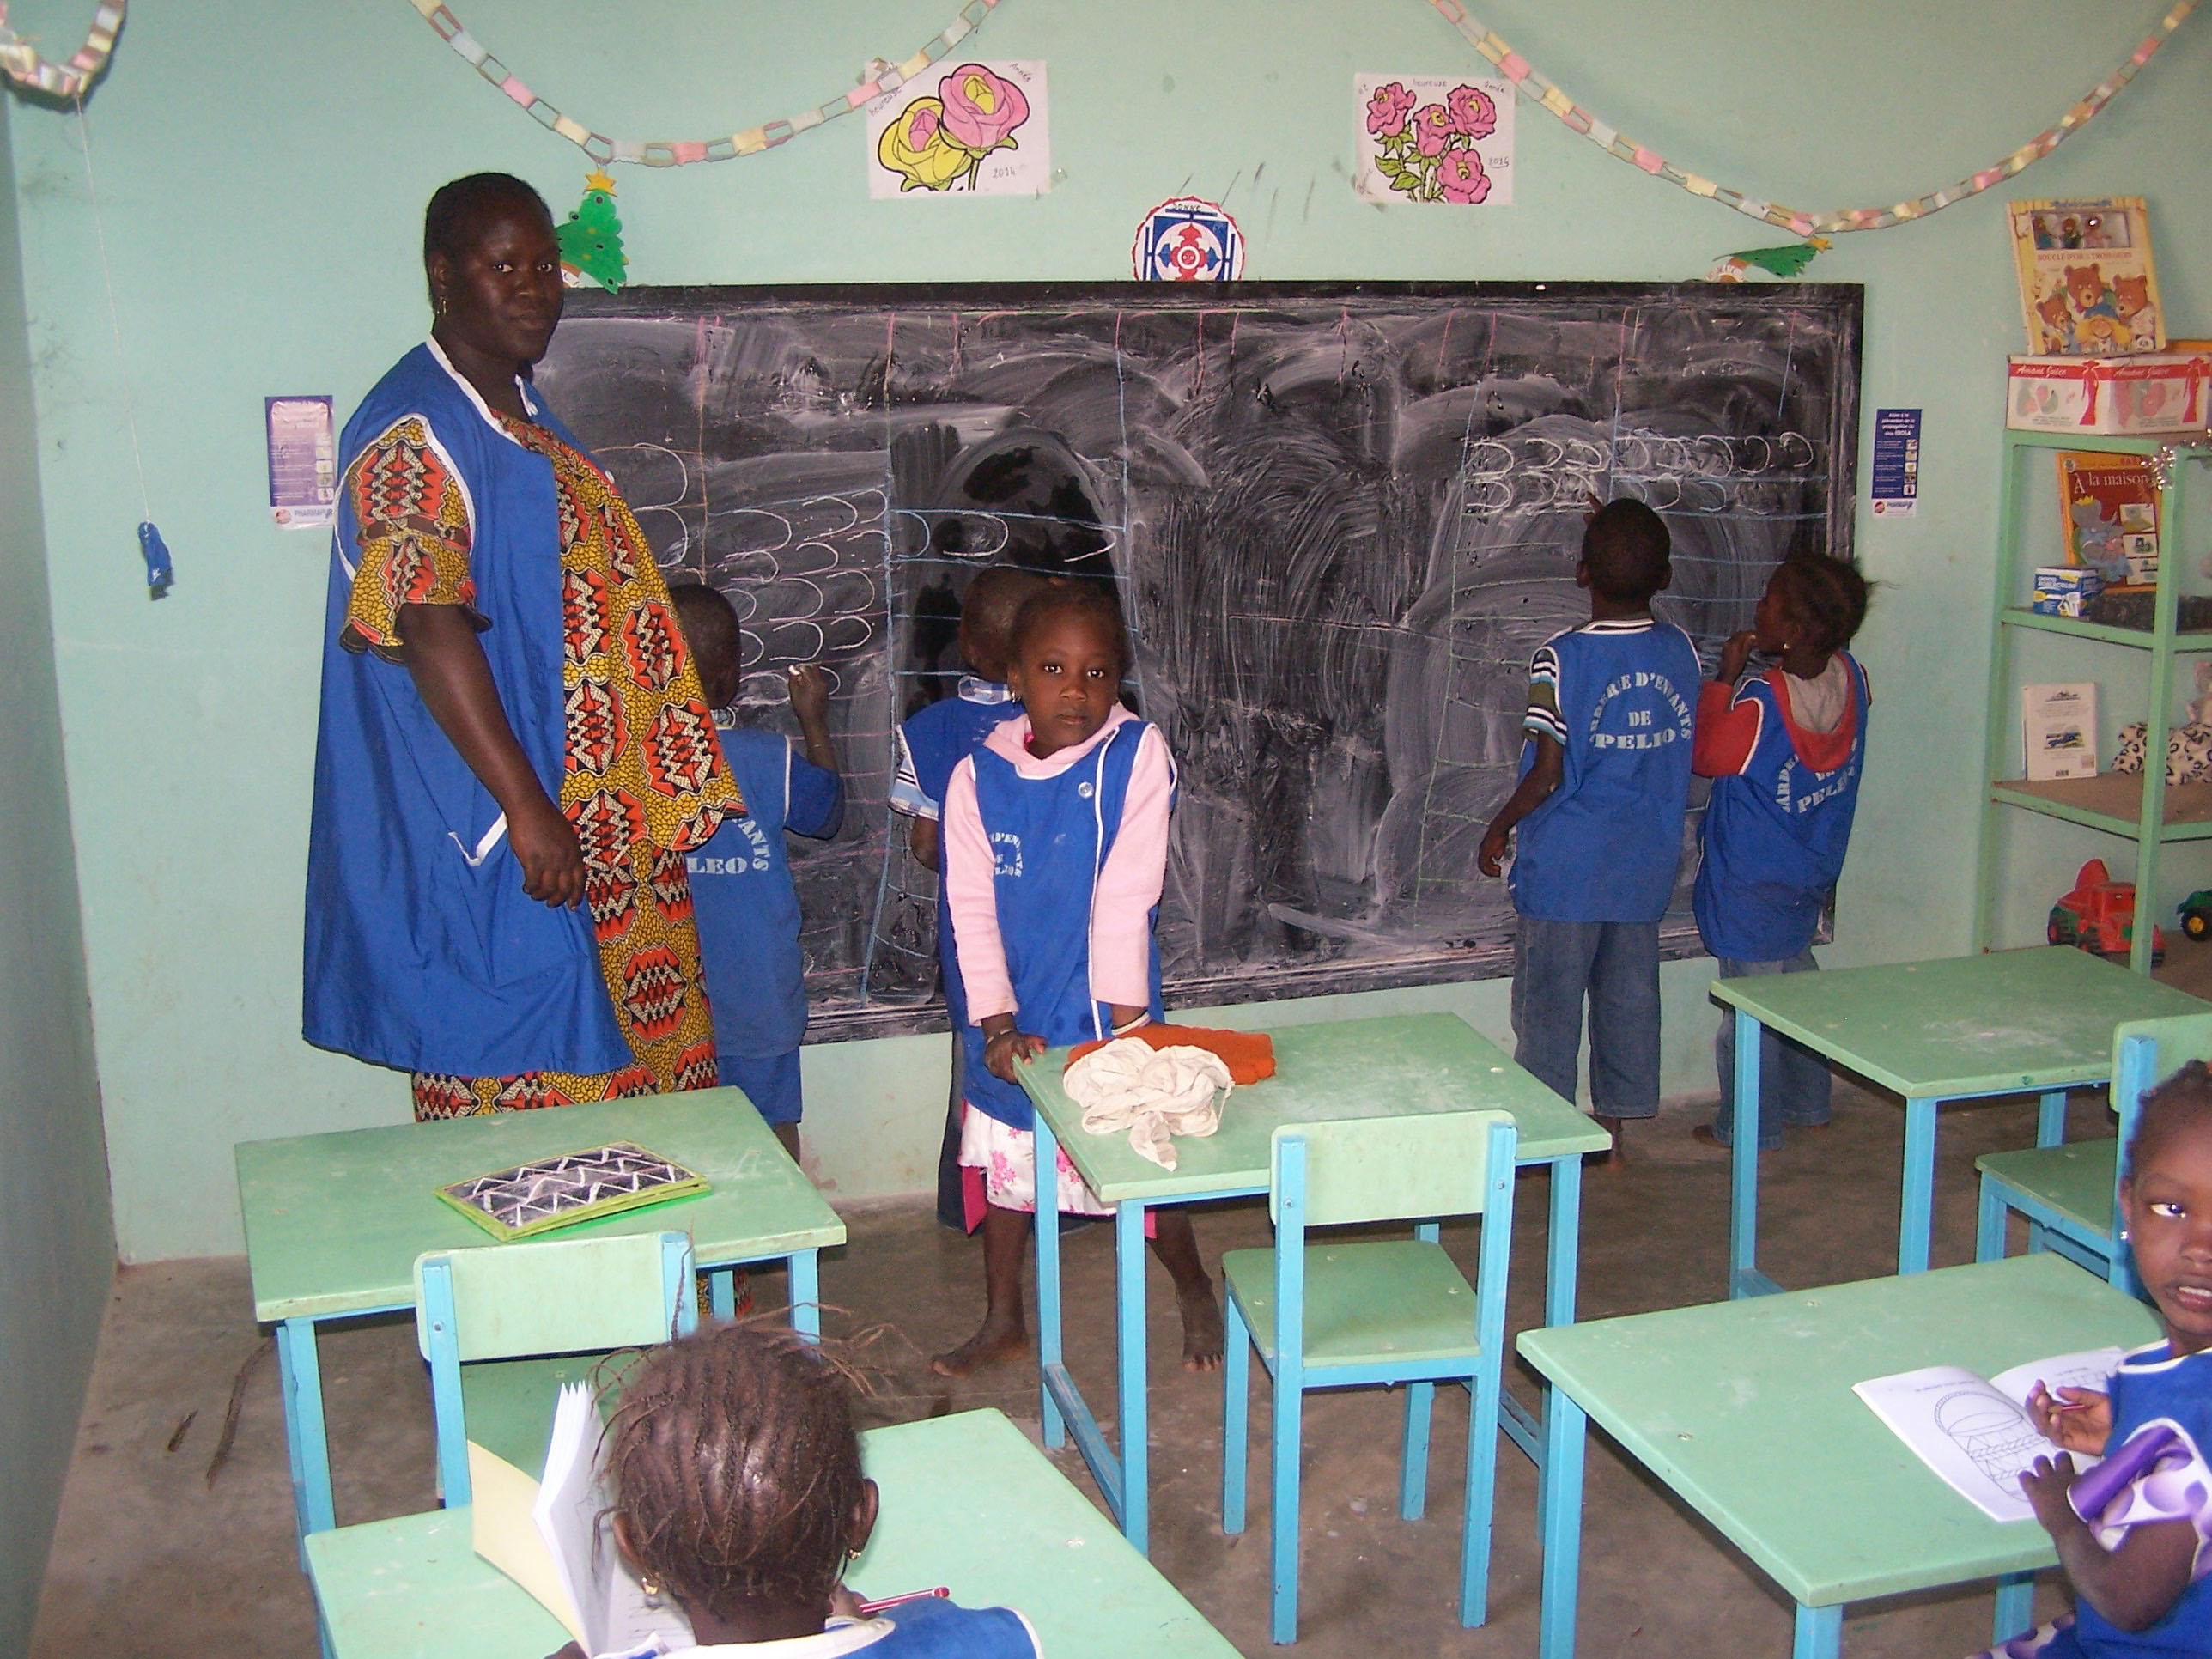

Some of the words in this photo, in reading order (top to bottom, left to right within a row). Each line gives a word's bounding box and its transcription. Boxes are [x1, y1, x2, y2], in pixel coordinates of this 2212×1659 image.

[2088, 472, 2100, 486] la
[2103, 472, 2149, 486] maison
[1628, 710, 1652, 727] DE
